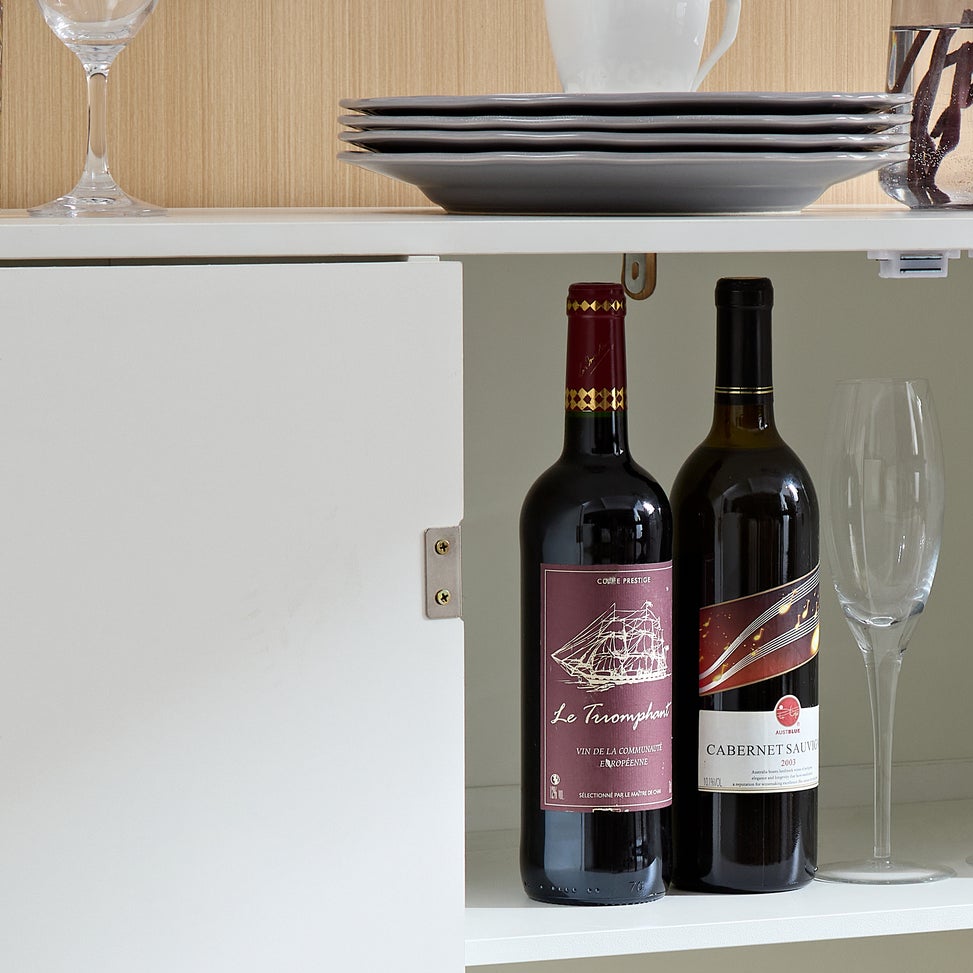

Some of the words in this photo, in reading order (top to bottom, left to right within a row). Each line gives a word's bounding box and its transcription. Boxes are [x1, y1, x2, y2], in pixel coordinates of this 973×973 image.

[622, 576, 651, 584] PRESTIGE
[550, 702, 577, 724] Le
[583, 701, 672, 730] Triomphant
[576, 747, 591, 755] VIN
[593, 747, 604, 755] DE
[606, 746, 617, 755] LA
[706, 743, 784, 756] CABERNET
[781, 759, 796, 767] 2003
